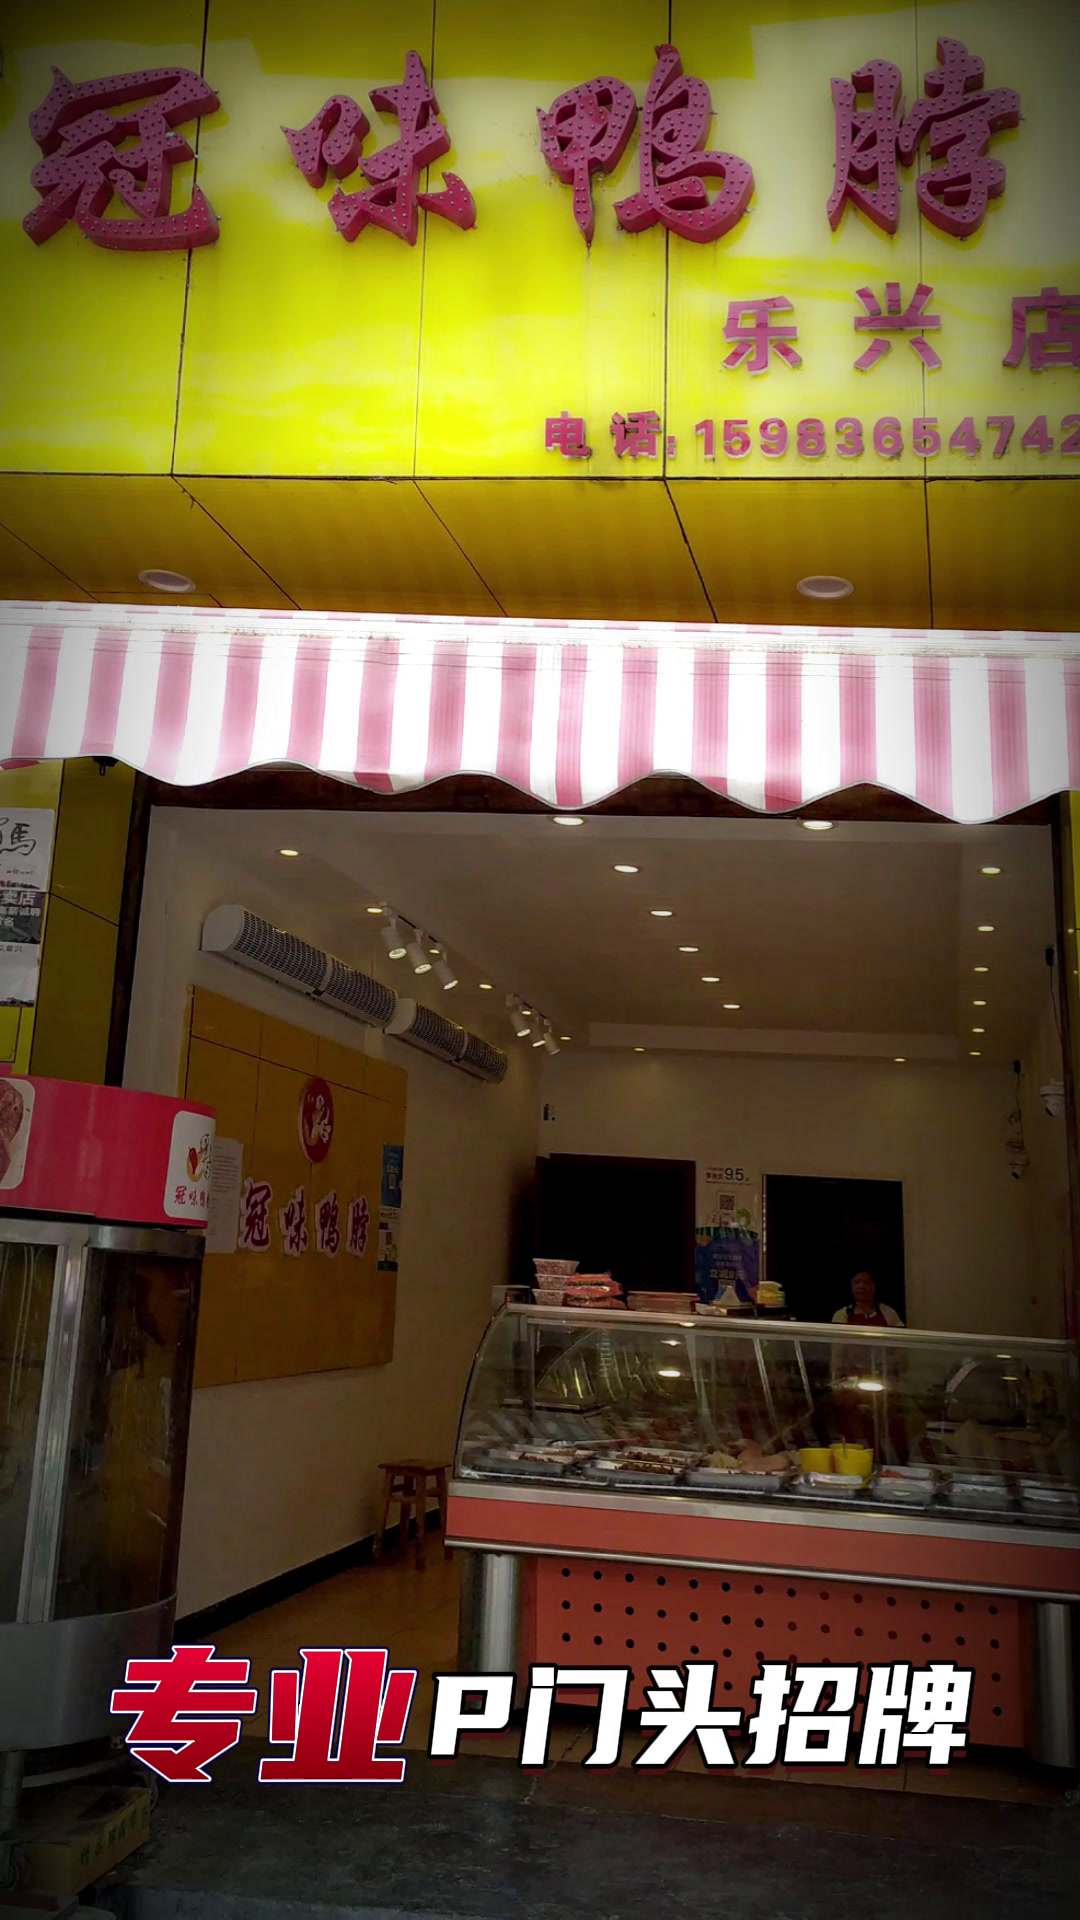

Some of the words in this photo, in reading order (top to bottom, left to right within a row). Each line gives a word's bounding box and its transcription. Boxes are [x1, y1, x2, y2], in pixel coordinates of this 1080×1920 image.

[22, 37, 1021, 251] 冠味鸭脖
[721, 282, 1080, 376] 乐兴店
[174, 1185, 208, 1209] 冠味鸭
[241, 1180, 369, 1256] 冠味鸭脖
